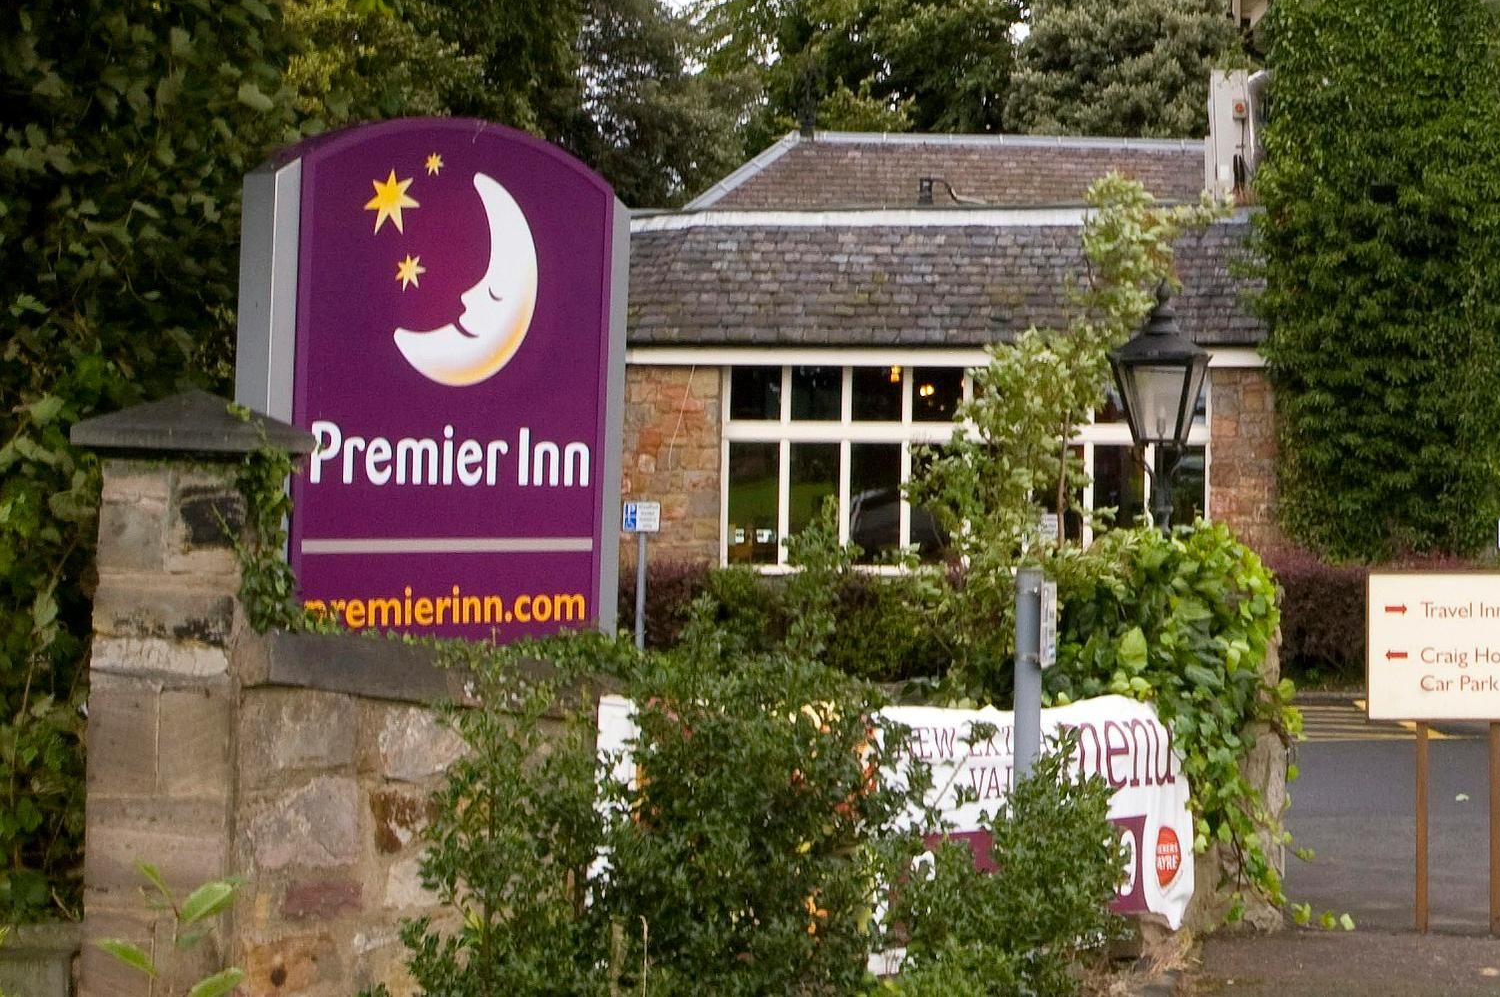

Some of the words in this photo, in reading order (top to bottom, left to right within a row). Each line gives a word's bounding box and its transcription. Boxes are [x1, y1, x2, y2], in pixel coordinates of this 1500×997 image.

[310, 420, 509, 486] Premier
[518, 427, 590, 486] Inn
[1420, 601, 1473, 619] Travel
[1420, 647, 1469, 668] Craig
[1420, 674, 1453, 692] Car
[1460, 674, 1499, 692] Park
